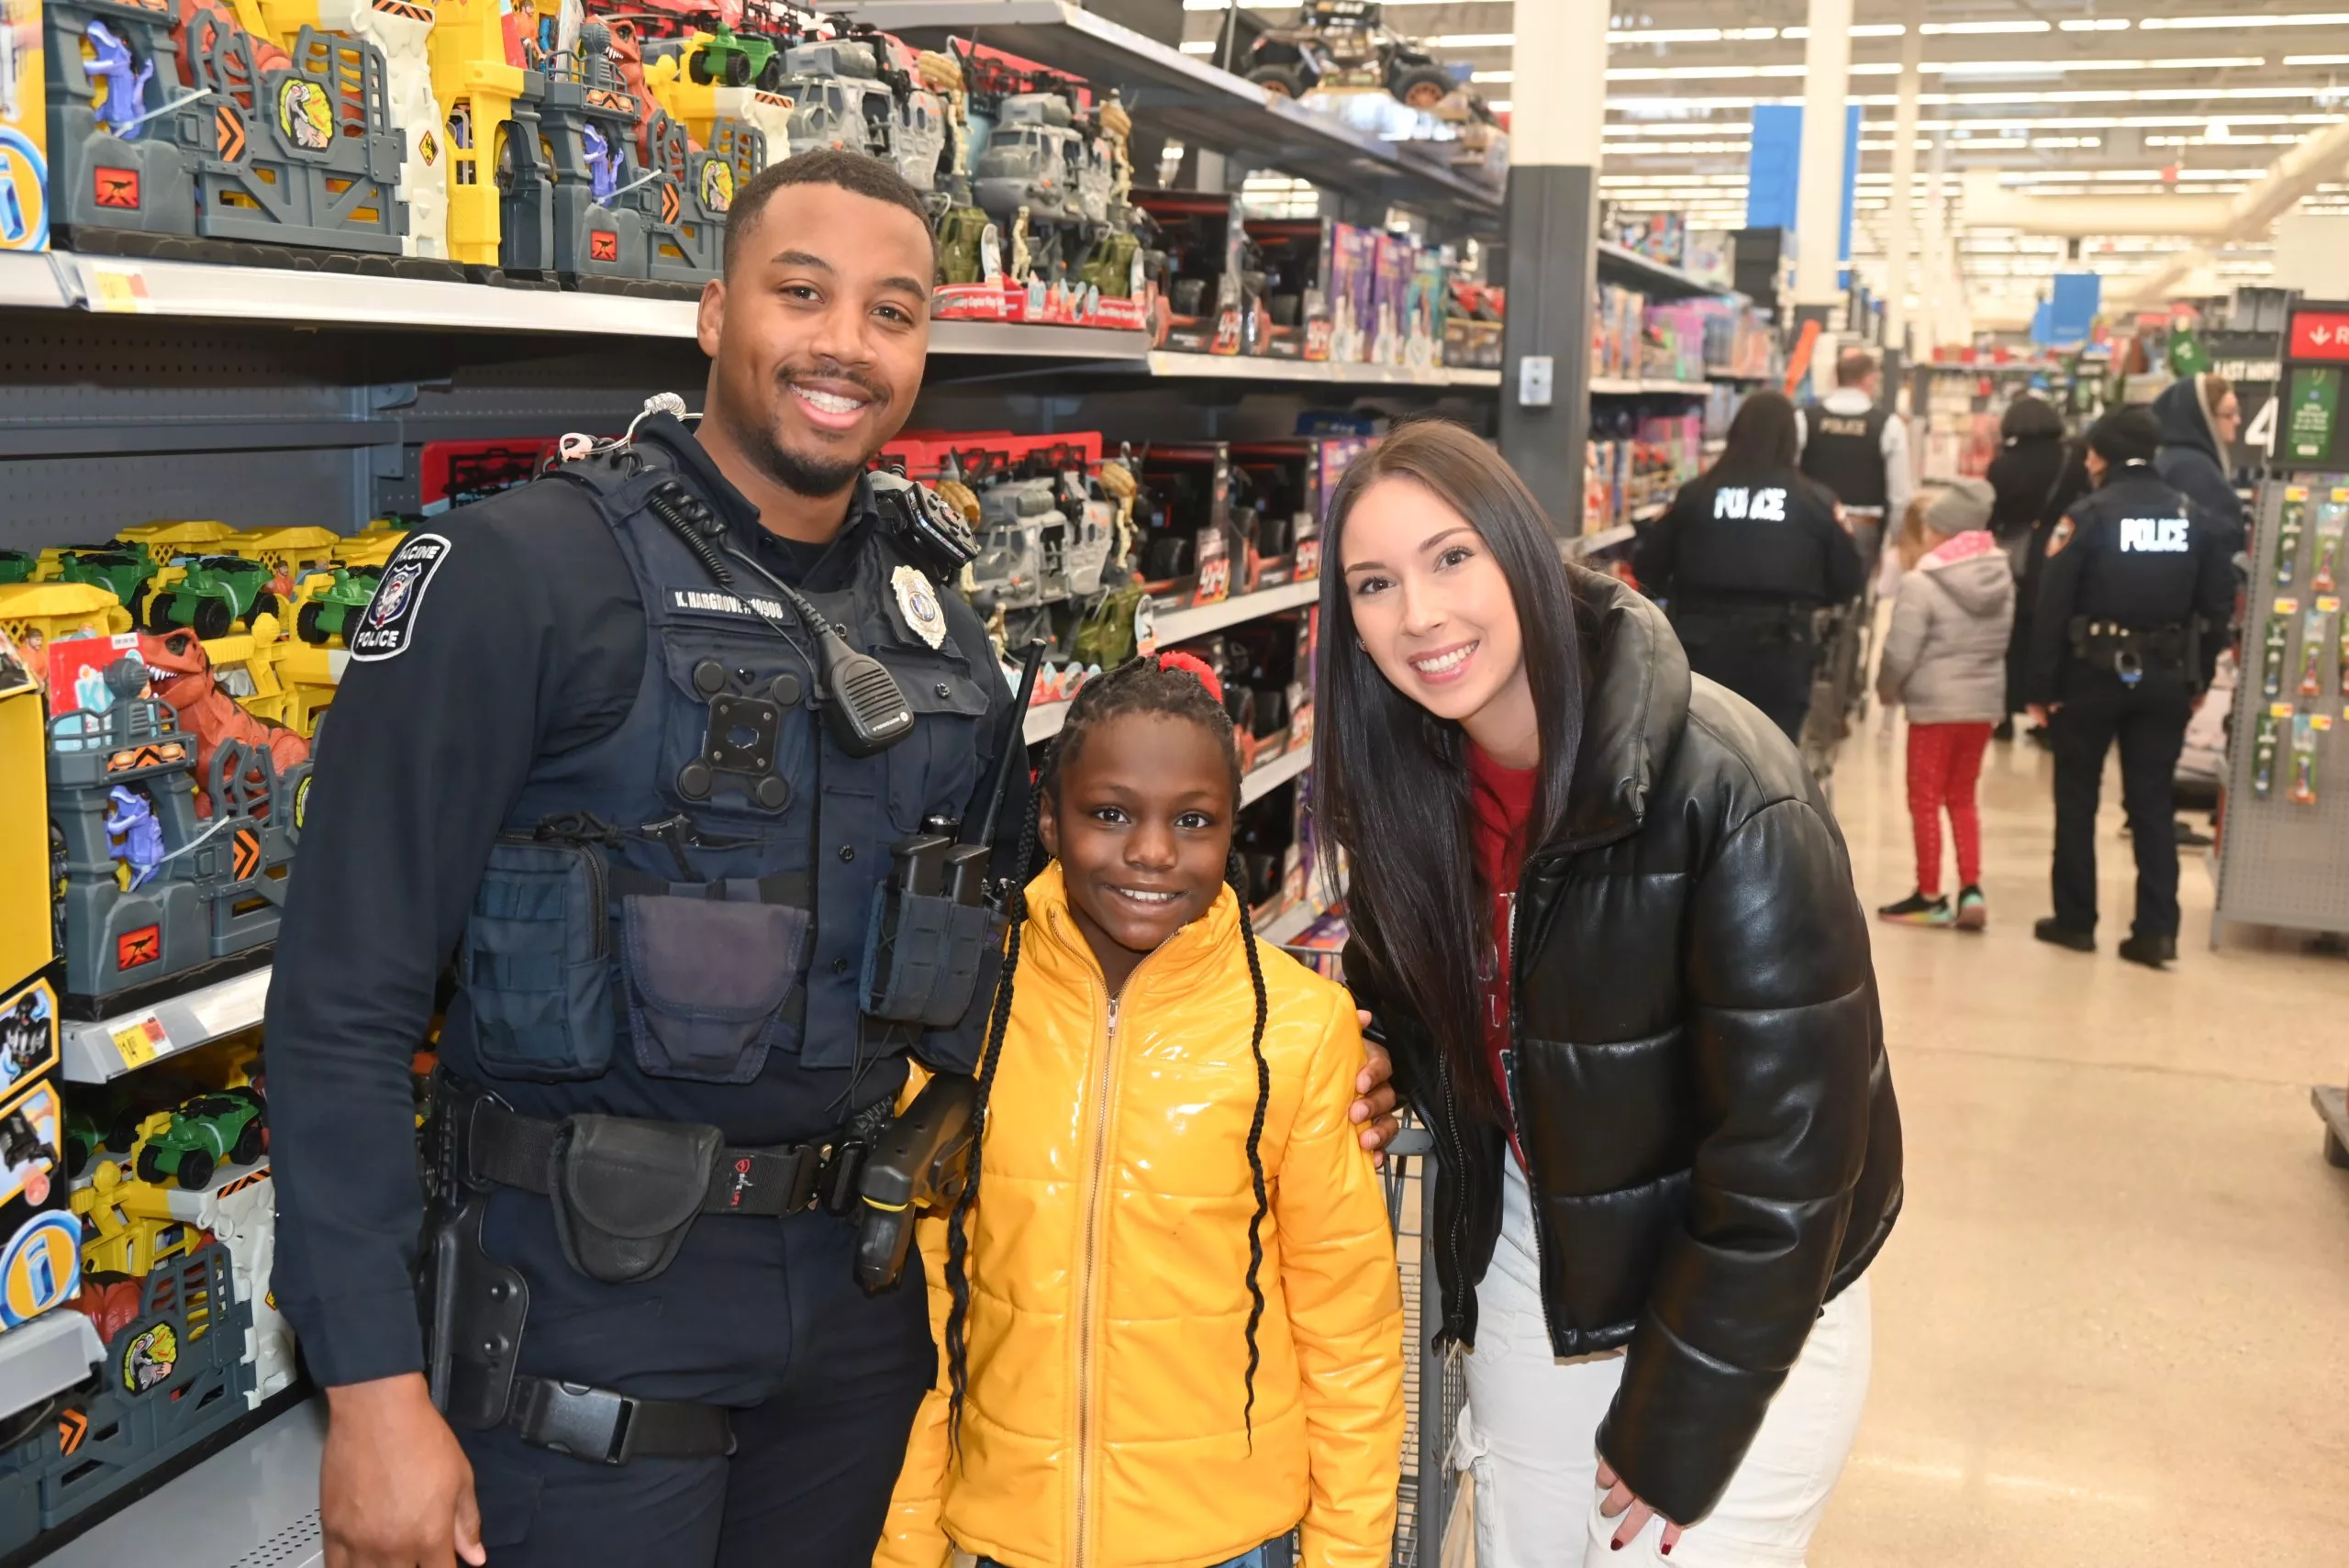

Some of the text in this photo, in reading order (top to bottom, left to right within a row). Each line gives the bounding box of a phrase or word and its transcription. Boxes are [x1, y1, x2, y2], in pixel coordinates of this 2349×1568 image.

[2244, 396, 2279, 457] 4
[2120, 517, 2190, 552] POLICE
[398, 545, 440, 561] ACINE
[356, 629, 400, 649] POLICE
